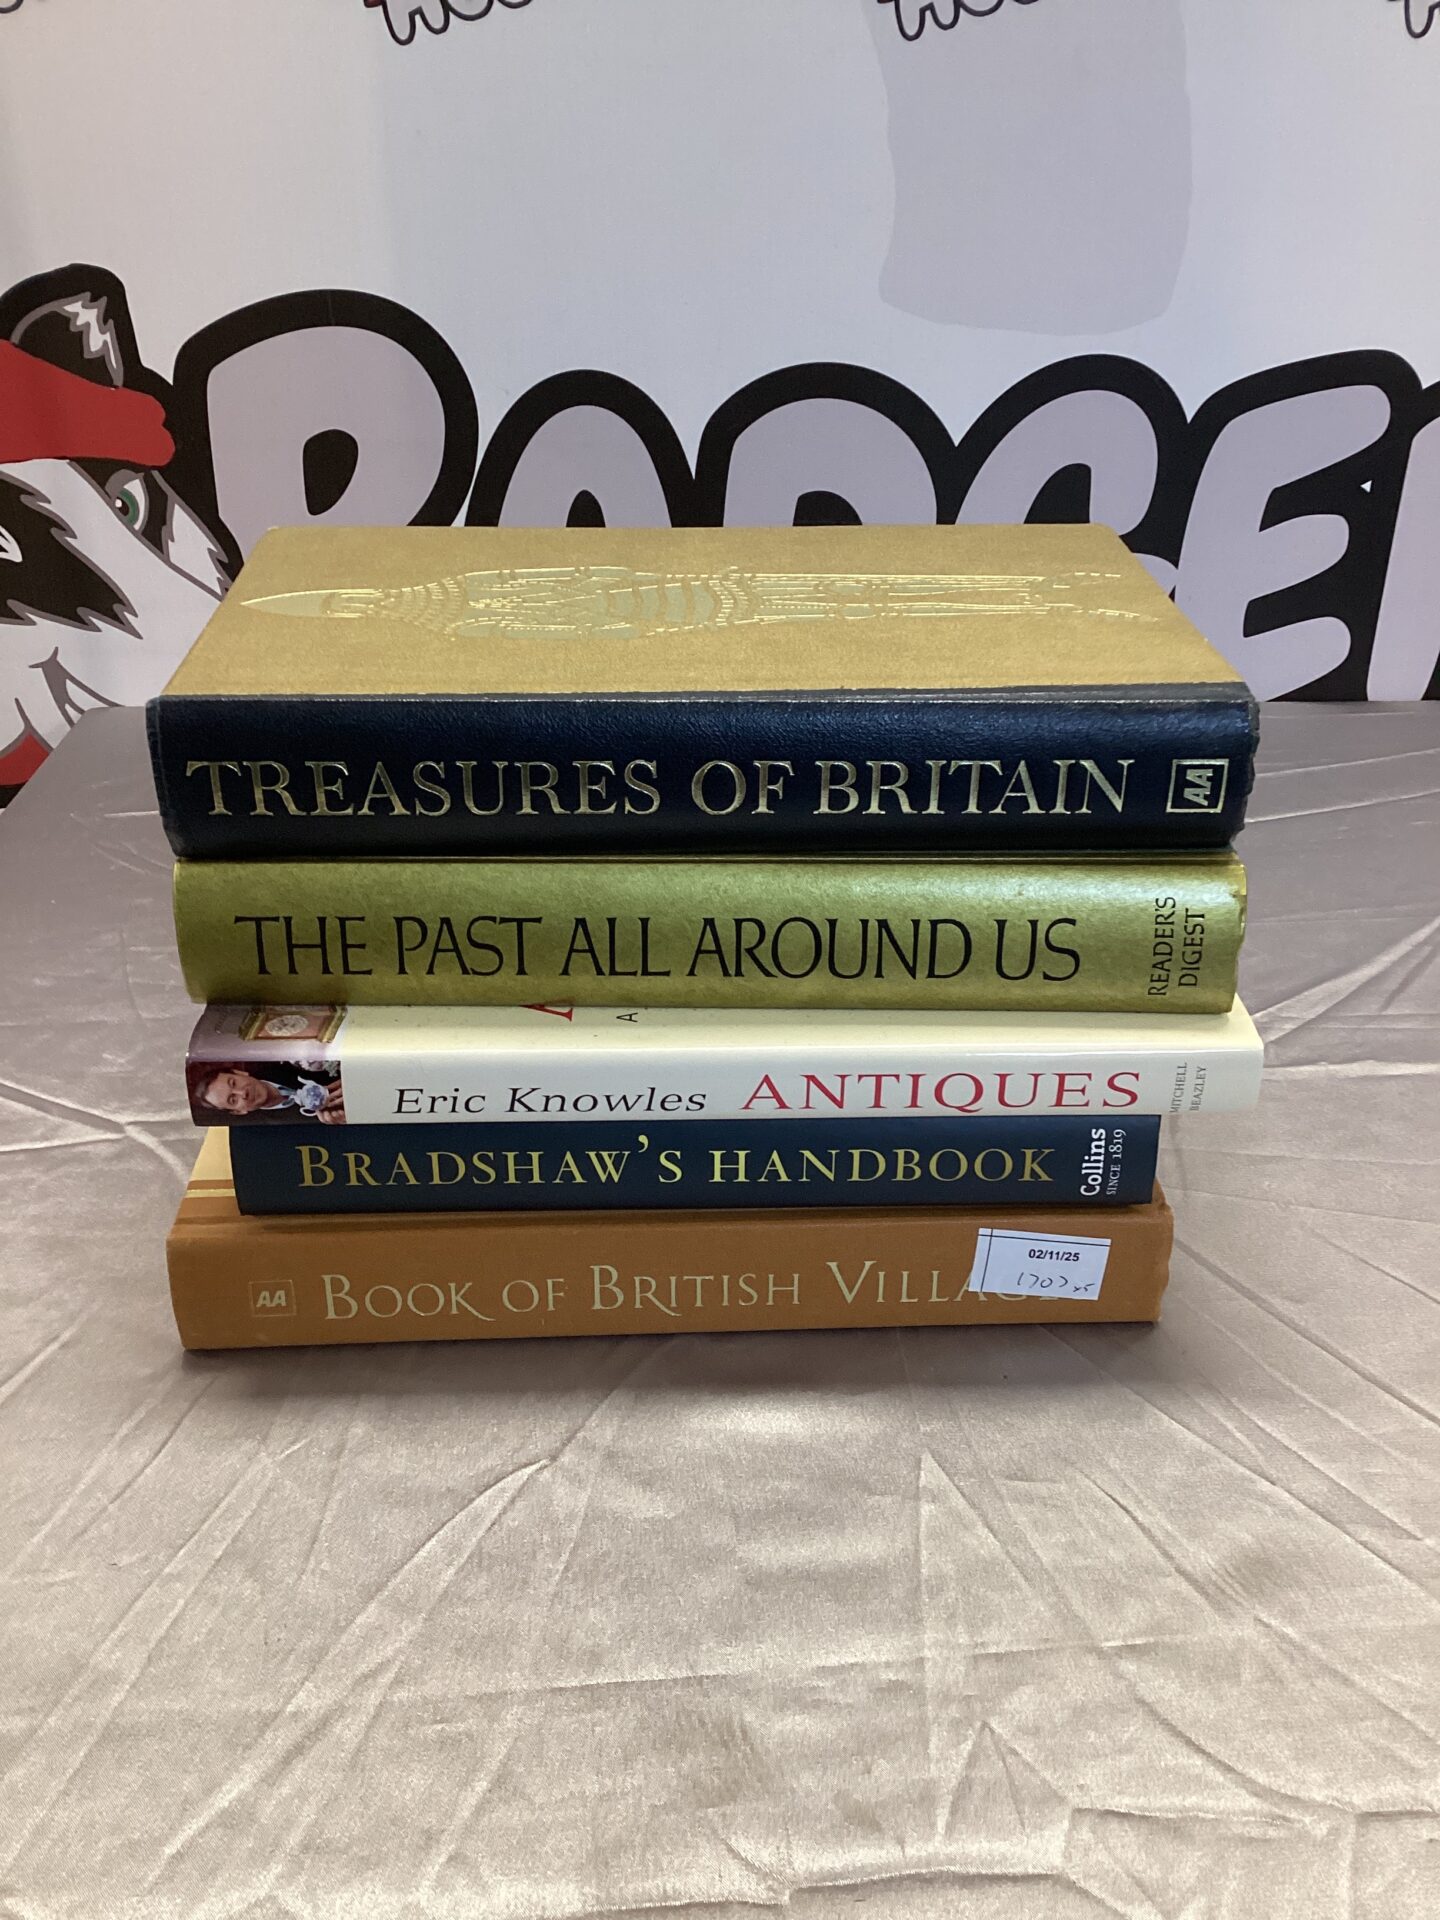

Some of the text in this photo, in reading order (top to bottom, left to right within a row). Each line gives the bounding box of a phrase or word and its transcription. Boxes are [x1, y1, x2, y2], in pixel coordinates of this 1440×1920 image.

[185, 758, 1136, 817] TREASURES OF BRITAIN
[233, 915, 1081, 982] THE PAST ALL AROUND US
[1148, 896, 1176, 996] READER'S
[1178, 907, 1205, 988] DIGEST
[392, 1086, 708, 1115] Eric Knowles
[741, 1071, 1141, 1112] ANTIQUES
[1189, 1065, 1207, 1111] BEAZLEY
[295, 1134, 1055, 1187] BRADSHAW'S HANDBOOK
[1080, 1128, 1107, 1197] Collins
[1106, 1129, 1127, 1196] SINCE 1819
[1028, 1248, 1080, 1262] 02/11/25
[321, 1274, 497, 1322] BOOK
[501, 1278, 568, 1312] OF
[590, 1263, 799, 1317] BRITISH
